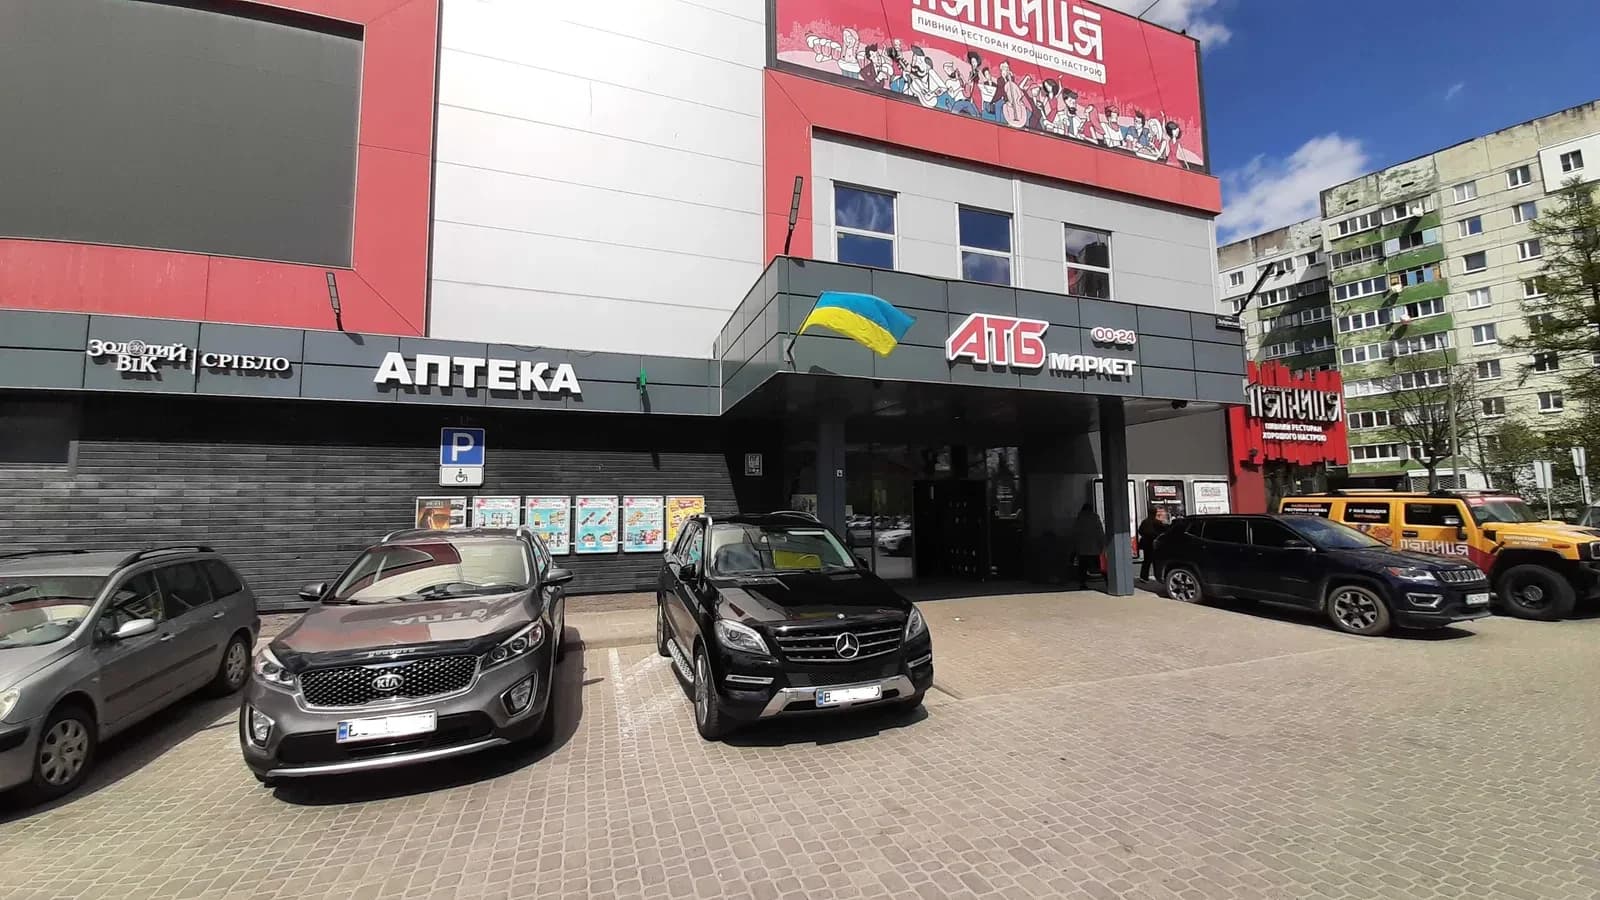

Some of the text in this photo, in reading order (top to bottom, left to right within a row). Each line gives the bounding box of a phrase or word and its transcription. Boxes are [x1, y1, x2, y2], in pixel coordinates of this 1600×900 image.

[917, 16, 1103, 78] ПИВНИЙ РЕСТОРАН ХОРОШОГО НАСТРОЮ
[945, 313, 1049, 369] АТБ
[1091, 327, 1137, 345] 00-24
[201, 352, 291, 372] СРІБЛО
[373, 351, 582, 394] АПТЕКА
[1049, 352, 1137, 376] МАРКЕТ
[451, 432, 475, 462] P
[376, 678, 399, 688] KIA
